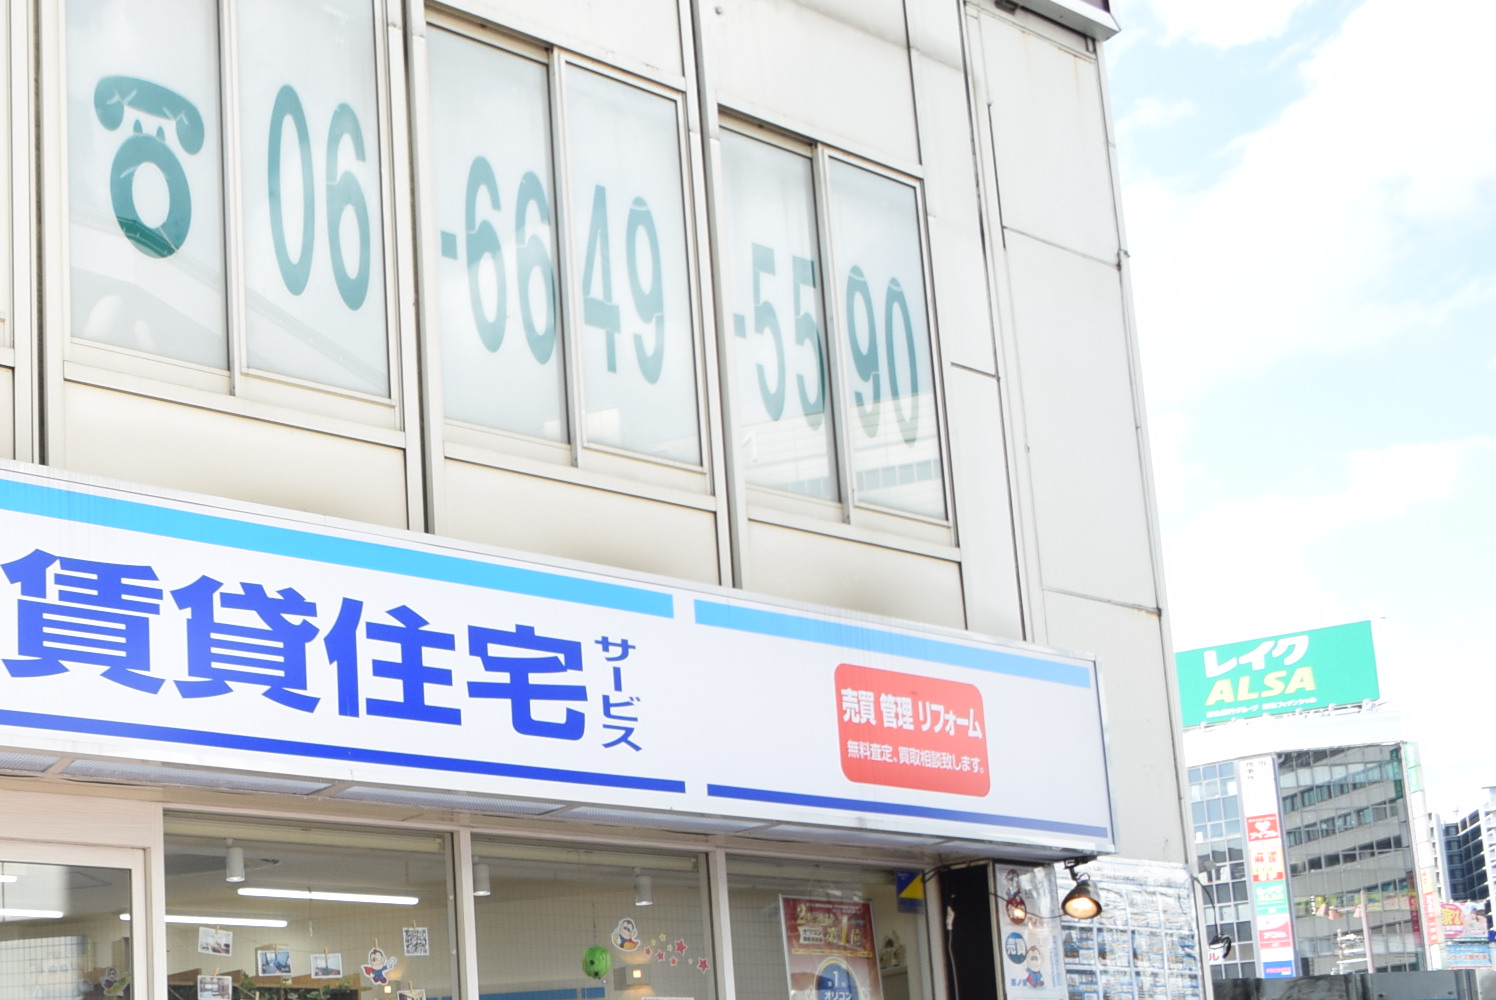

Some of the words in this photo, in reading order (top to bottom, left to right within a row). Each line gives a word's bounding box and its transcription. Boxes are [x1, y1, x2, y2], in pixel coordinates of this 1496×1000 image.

[267, 84, 372, 312] 06
[0, 548, 589, 741] 賃貸住宅
[593, 634, 643, 752] サービス
[1203, 634, 1309, 678] レイク
[1204, 666, 1317, 706] ALSA
[840, 688, 877, 726] 売買
[879, 693, 915, 731] 管理
[918, 700, 984, 740] リフォーム
[847, 739, 984, 774] 無料査定、買取相談致します。
[824, 991, 852, 1000] オリコン
